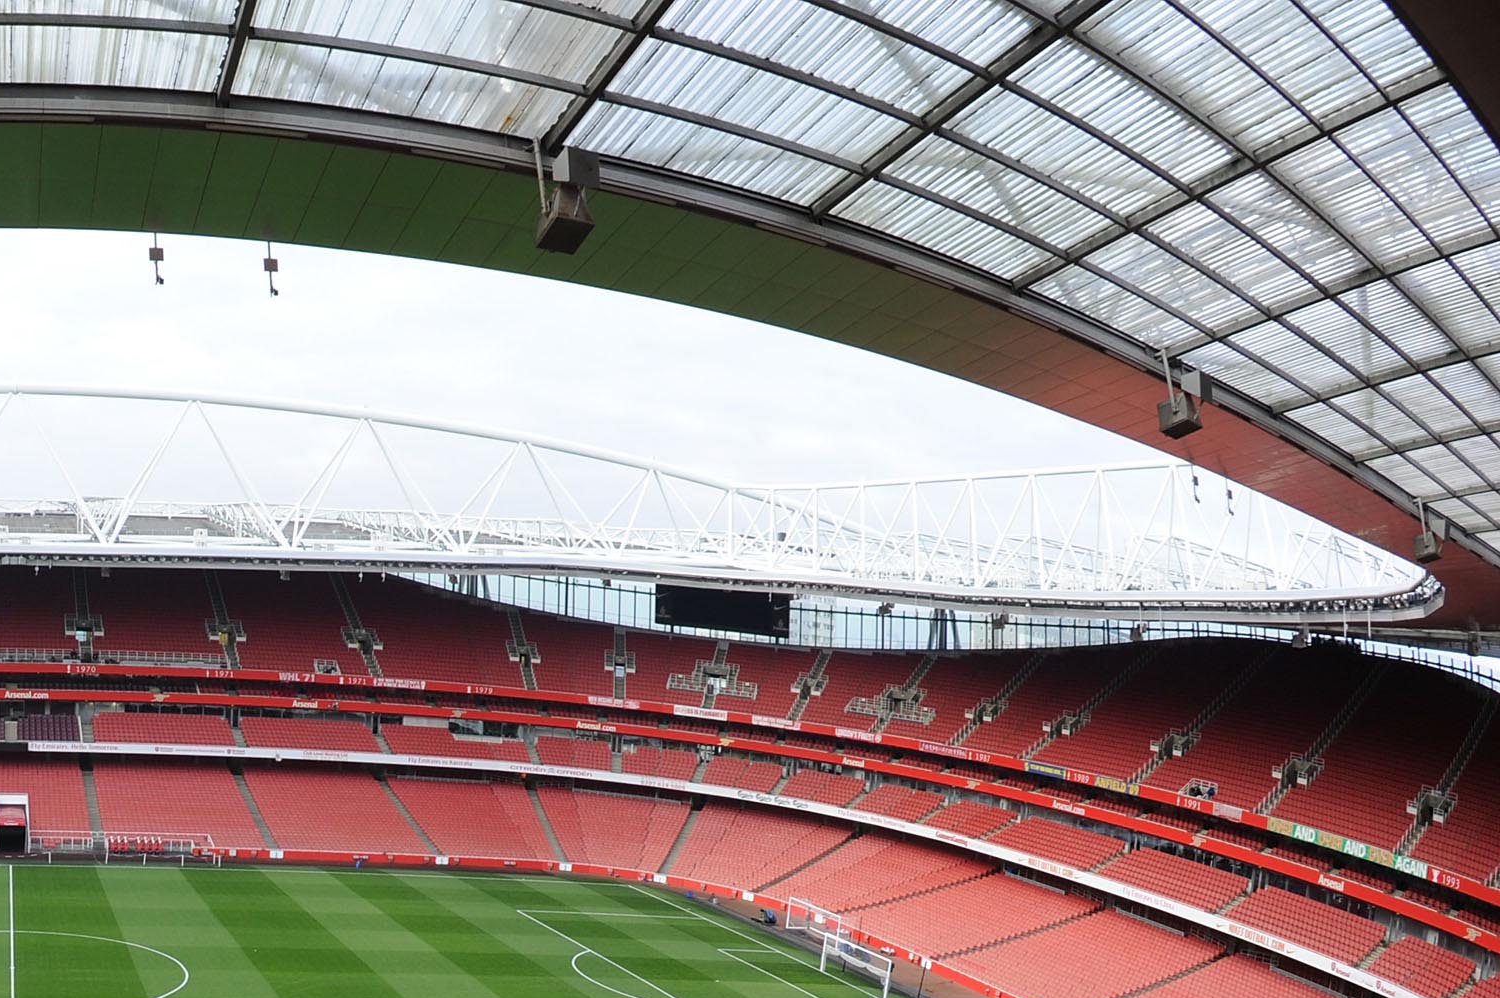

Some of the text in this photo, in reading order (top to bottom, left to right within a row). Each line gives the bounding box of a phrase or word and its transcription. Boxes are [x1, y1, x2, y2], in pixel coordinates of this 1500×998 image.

[279, 672, 301, 682] WHL
[5, 691, 49, 700] Arsenal.com
[292, 700, 318, 709] Arsenal
[576, 721, 617, 733] Arsenal.com
[842, 757, 865, 768] Arsenal
[975, 752, 991, 763] 1987
[1073, 773, 1090, 785] 1989
[1096, 776, 1127, 792] ANFIELD
[1052, 800, 1086, 816] Arsenal.com
[1184, 798, 1202, 811] 1991
[1296, 826, 1316, 843] AND
[1344, 841, 1365, 859] AND
[1395, 855, 1428, 880] AGAIN
[1318, 874, 1344, 892] Arsenal
[1442, 873, 1461, 890] 1993
